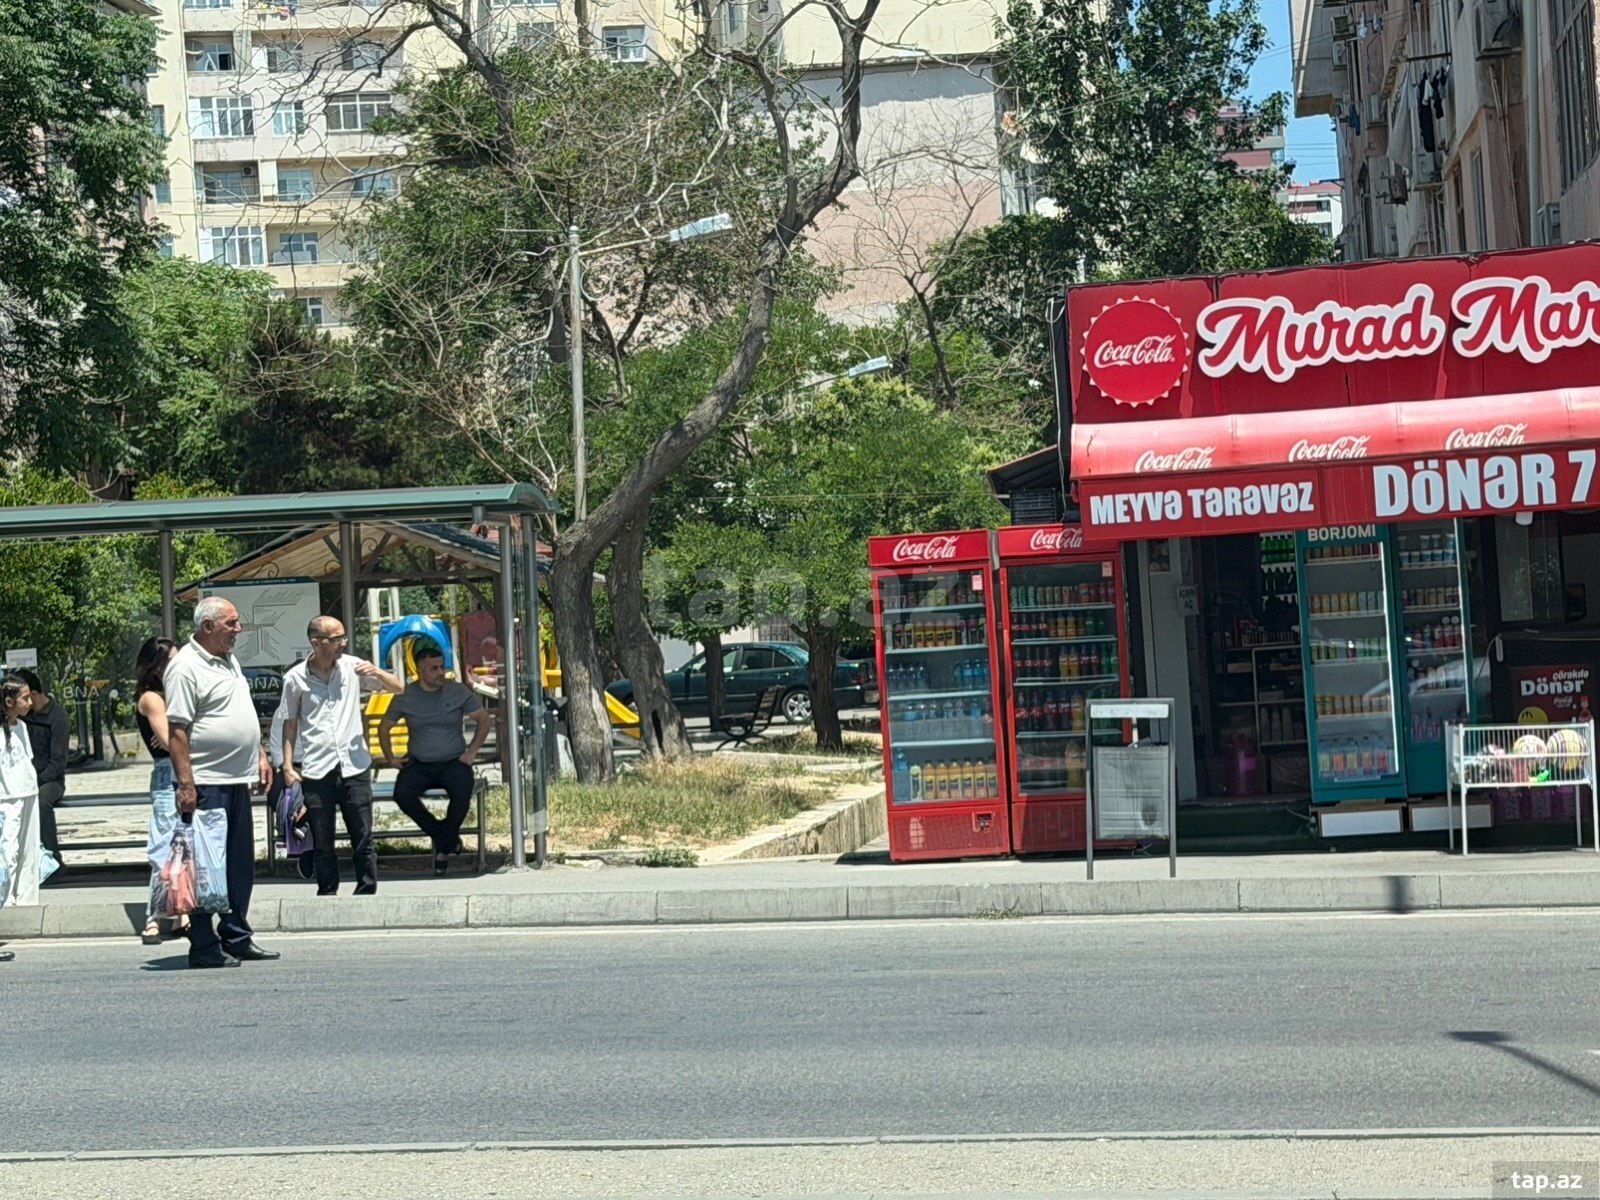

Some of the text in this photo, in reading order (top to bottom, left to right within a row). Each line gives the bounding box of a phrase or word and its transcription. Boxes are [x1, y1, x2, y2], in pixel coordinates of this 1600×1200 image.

[1197, 283, 1446, 383] Murad
[1094, 335, 1176, 369] Coca-Cola
[1568, 449, 1596, 503] 7
[1030, 527, 1083, 550] Coca-Cola
[1307, 524, 1376, 542] BORJOMI
[893, 536, 960, 562] Coca-Cola
[63, 685, 100, 699] BNA
[1520, 677, 1585, 696] Dönər
